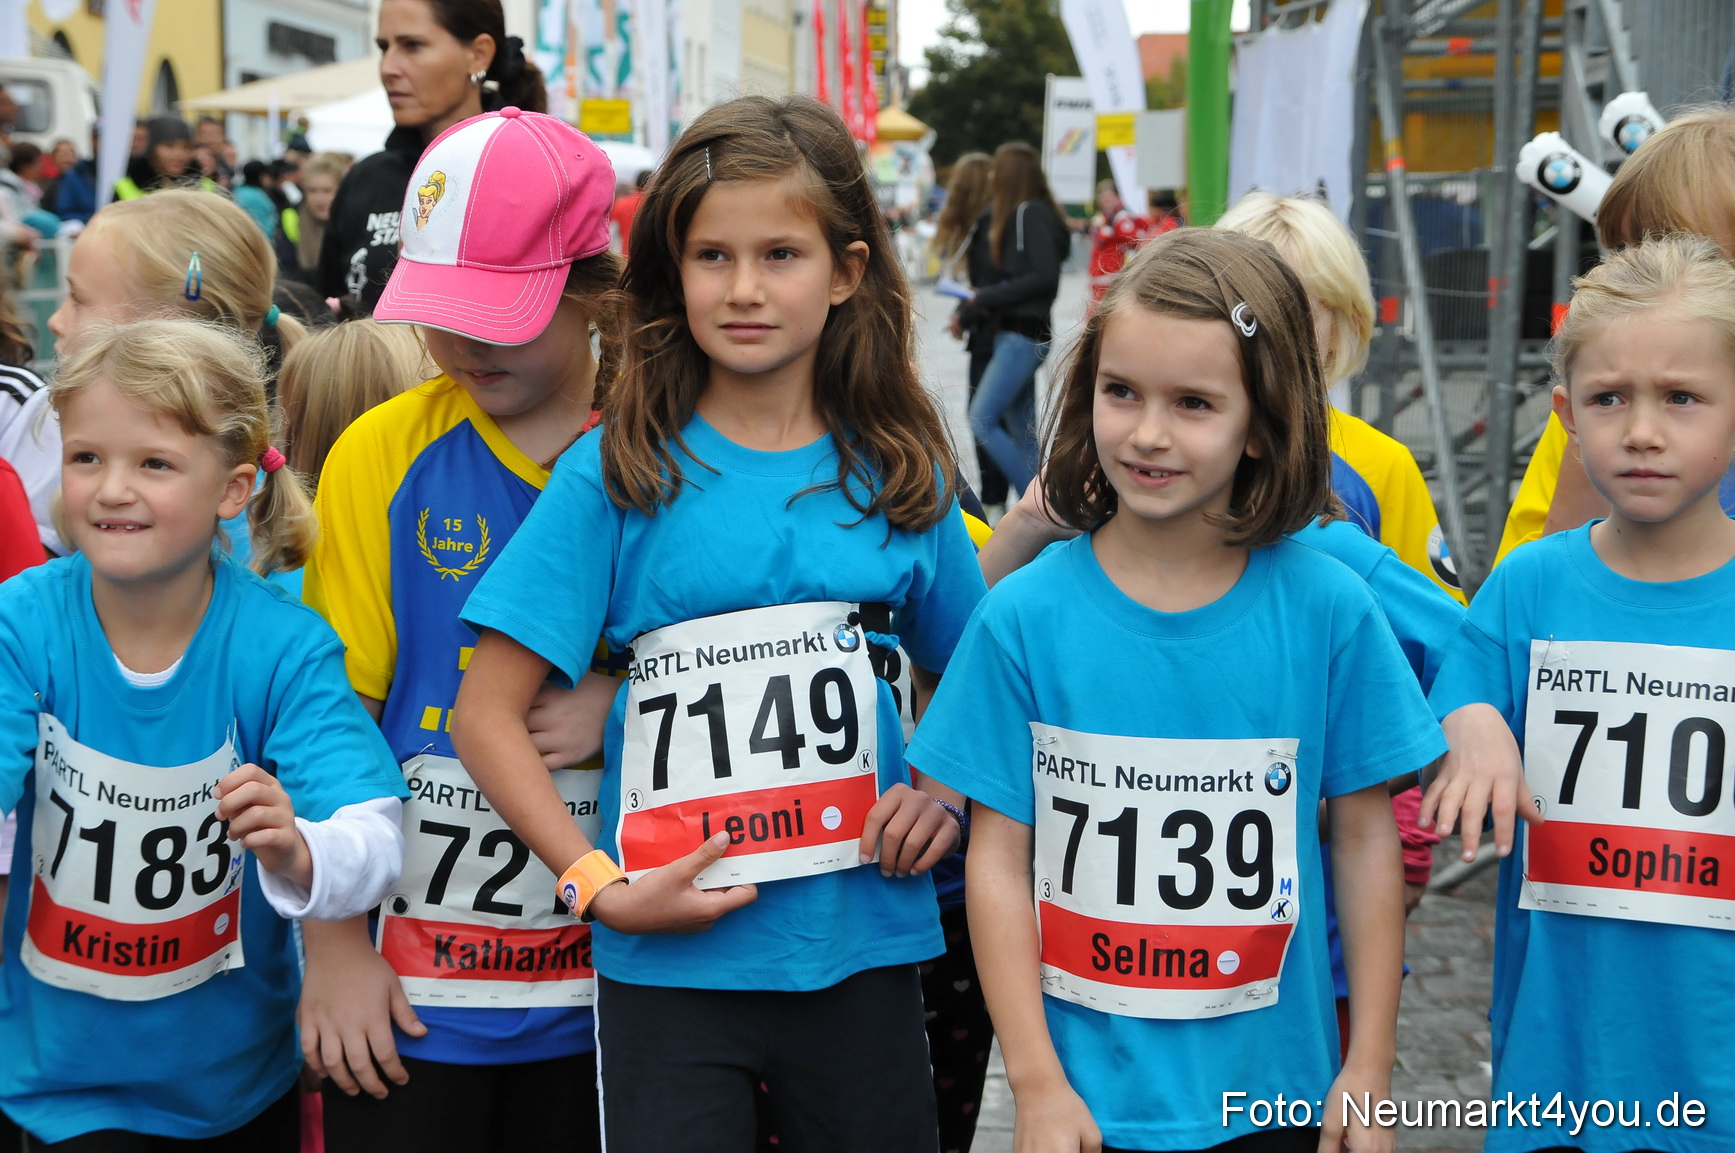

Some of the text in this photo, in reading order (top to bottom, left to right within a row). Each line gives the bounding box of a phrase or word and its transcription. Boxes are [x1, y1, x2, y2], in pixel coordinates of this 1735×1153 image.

[432, 536, 474, 553] Jahre
[443, 518, 462, 532] 15
[696, 631, 828, 669] Neumarkt
[1536, 668, 1617, 694] PARTL
[638, 667, 859, 792] 7149
[43, 740, 90, 797] PARTL
[861, 753, 870, 769] K
[1036, 750, 1107, 788] PARTL
[1115, 765, 1254, 793] Neumarkt
[1554, 709, 1735, 817] 710
[407, 777, 491, 813] PARTL
[630, 792, 638, 809] 3
[50, 788, 232, 910] 7183
[1052, 795, 1274, 911] 7139
[1589, 837, 1720, 888] Sophia
[1043, 881, 1051, 898] 3
[1279, 877, 1292, 896] M
[63, 920, 180, 967] Kristin
[1092, 932, 1209, 978] Selma
